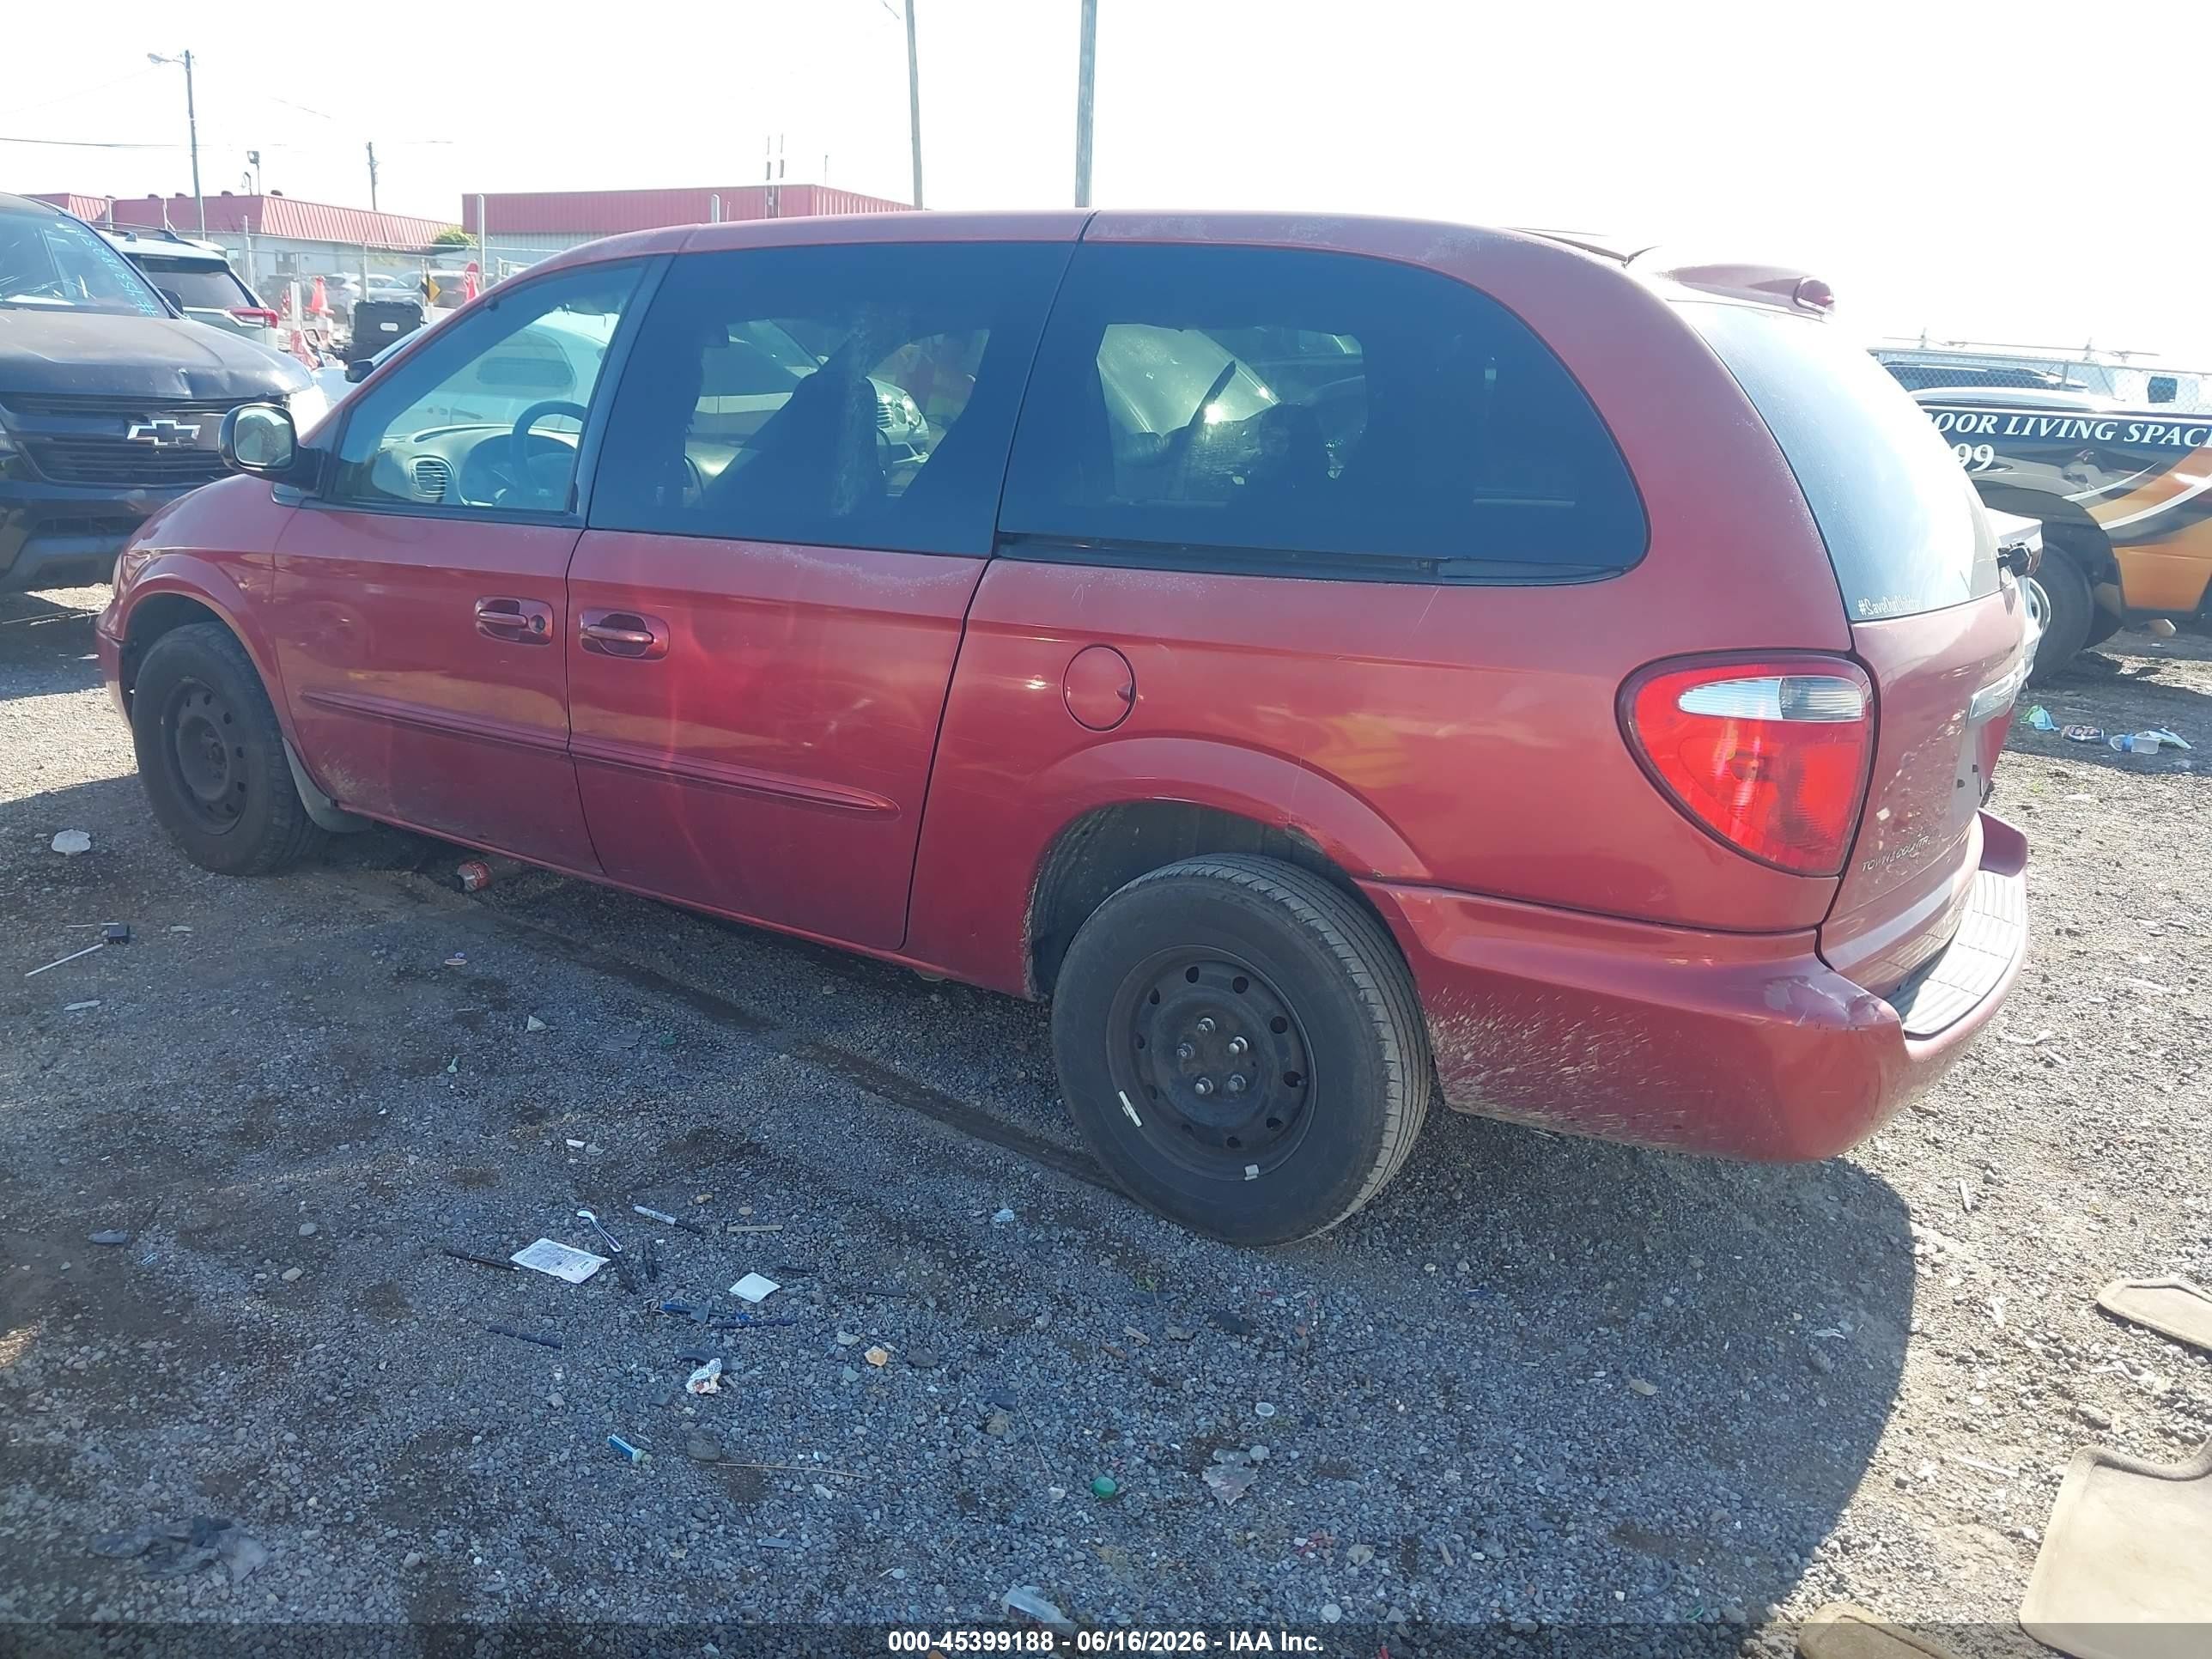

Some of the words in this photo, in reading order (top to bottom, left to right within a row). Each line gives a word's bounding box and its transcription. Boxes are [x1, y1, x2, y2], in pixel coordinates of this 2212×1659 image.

[1924, 412, 1999, 434] OOR
[2003, 416, 2118, 441] LIVING
[1857, 594, 1923, 616] #SaveOurChild
